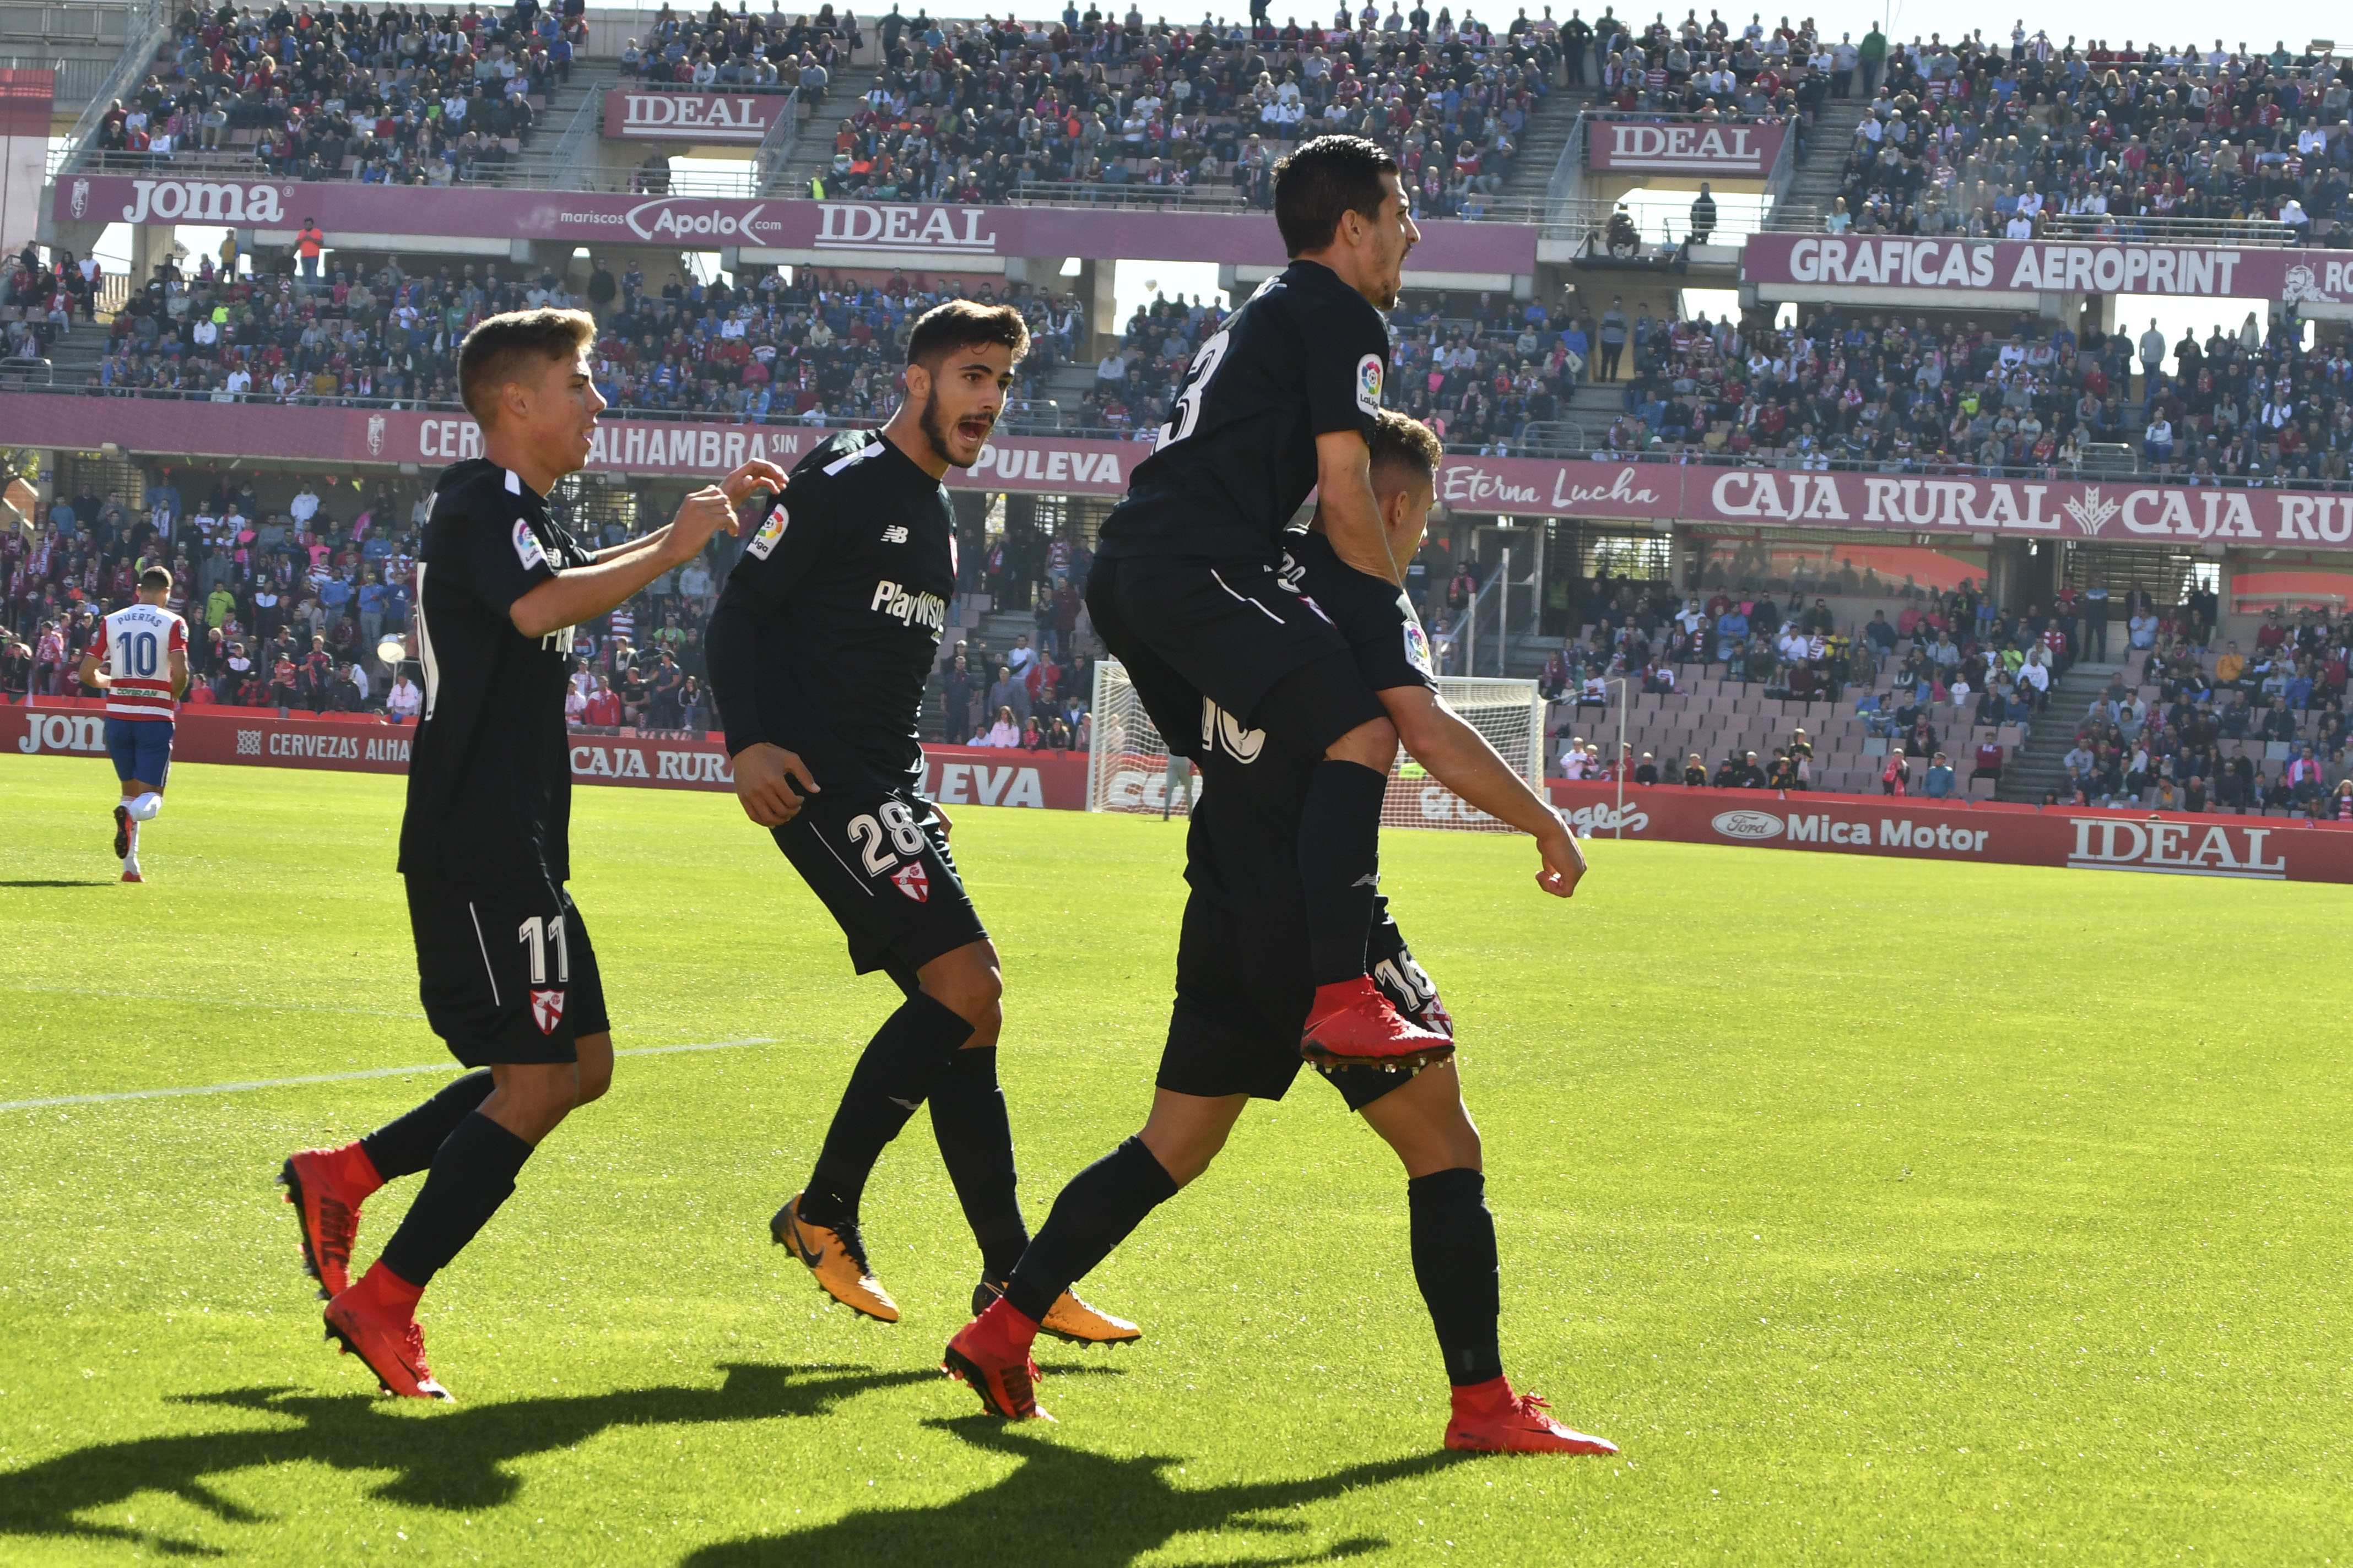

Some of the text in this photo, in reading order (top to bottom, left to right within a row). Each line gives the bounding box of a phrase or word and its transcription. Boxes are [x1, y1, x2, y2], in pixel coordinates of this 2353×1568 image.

[623, 95, 766, 128] IDEAL
[1610, 126, 1761, 160] IDEAL
[560, 210, 625, 225] mariscos
[653, 208, 738, 239] Apolo
[815, 204, 996, 246] IDEAL
[1790, 238, 2240, 295] GRAFICAS AEROPRINT
[588, 427, 766, 468] ALHAMBRA
[772, 433, 798, 453] SIN
[966, 444, 1122, 484] PULEVA
[1443, 466, 1659, 508] Eterna Lucha
[1712, 472, 2061, 529] CAJA RURAL
[2122, 490, 2262, 539] CAJA
[117, 612, 161, 627] PUERTAS
[116, 631, 157, 679] 10
[18, 713, 106, 753] Jom
[269, 733, 410, 762] CERVEZAS ALHA
[570, 746, 734, 783] CAJA RUR
[923, 762, 1045, 808] LEVA
[847, 801, 926, 877] 28
[1726, 813, 1989, 851] Ford Mica Motor
[2068, 818, 2285, 869] IDEAL
[518, 915, 569, 984] 11
